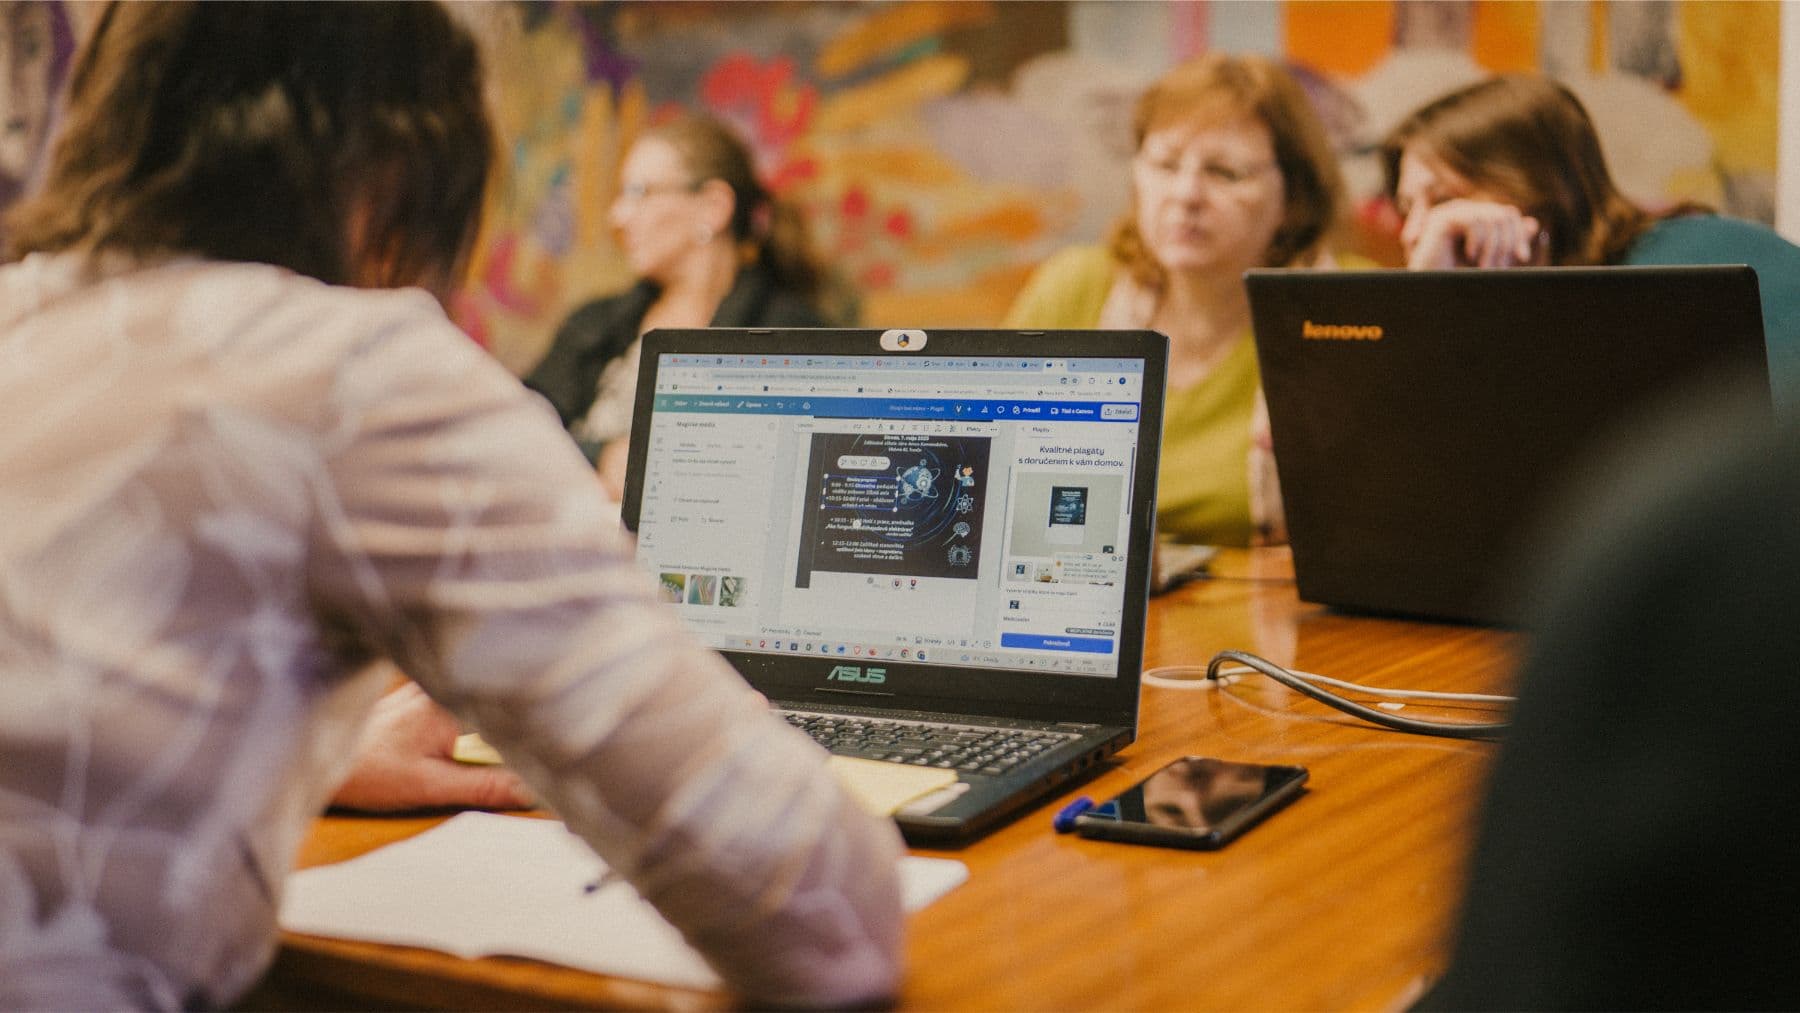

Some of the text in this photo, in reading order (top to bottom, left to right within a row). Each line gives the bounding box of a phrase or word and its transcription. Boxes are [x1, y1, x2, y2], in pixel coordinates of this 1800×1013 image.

[1302, 320, 1383, 339] lenovo
[1040, 445, 1105, 456] Kvalitné plagáty
[1024, 456, 1068, 466] doručením
[1069, 458, 1074, 466] k
[1075, 458, 1093, 467] vám
[1094, 458, 1125, 467] domov.
[827, 665, 887, 683] ASUS
